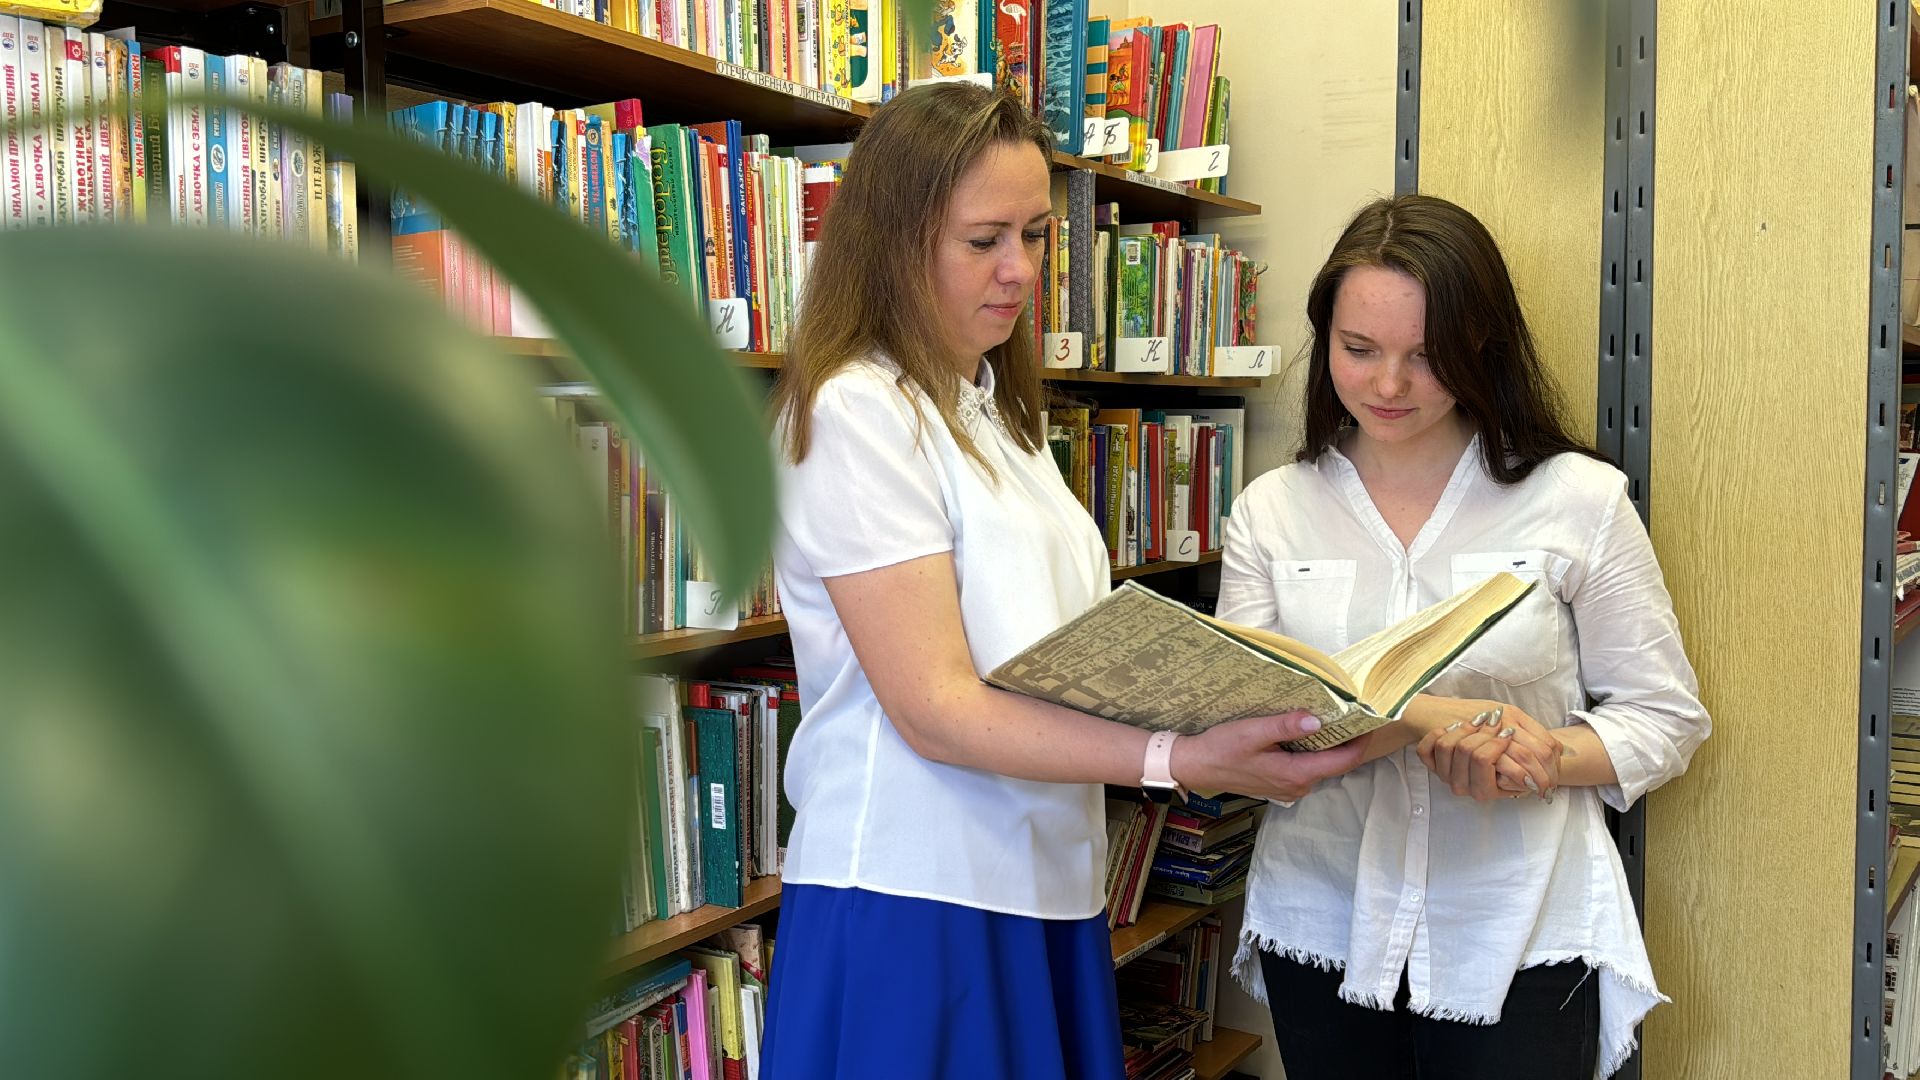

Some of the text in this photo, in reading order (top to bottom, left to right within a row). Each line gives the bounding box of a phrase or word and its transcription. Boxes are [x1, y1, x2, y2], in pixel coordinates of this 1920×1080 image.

[716, 61, 852, 111] ОТЕЧЕСТВЕННАЯ ЛИТЕРАТУРА
[132, 111, 144, 179] ЖИЛИ-БЫЛ
[191, 102, 201, 141] ЗЕМЛ
[9, 159, 22, 218] МИЛЛИОН
[33, 135, 46, 201] ДЕВОЧКА
[75, 126, 87, 212] ЖИВОТНЫХ
[98, 155, 114, 220] АМЕННЫЙ
[192, 155, 202, 215] ДЕВОЧКА
[1178, 535, 1193, 556] С
